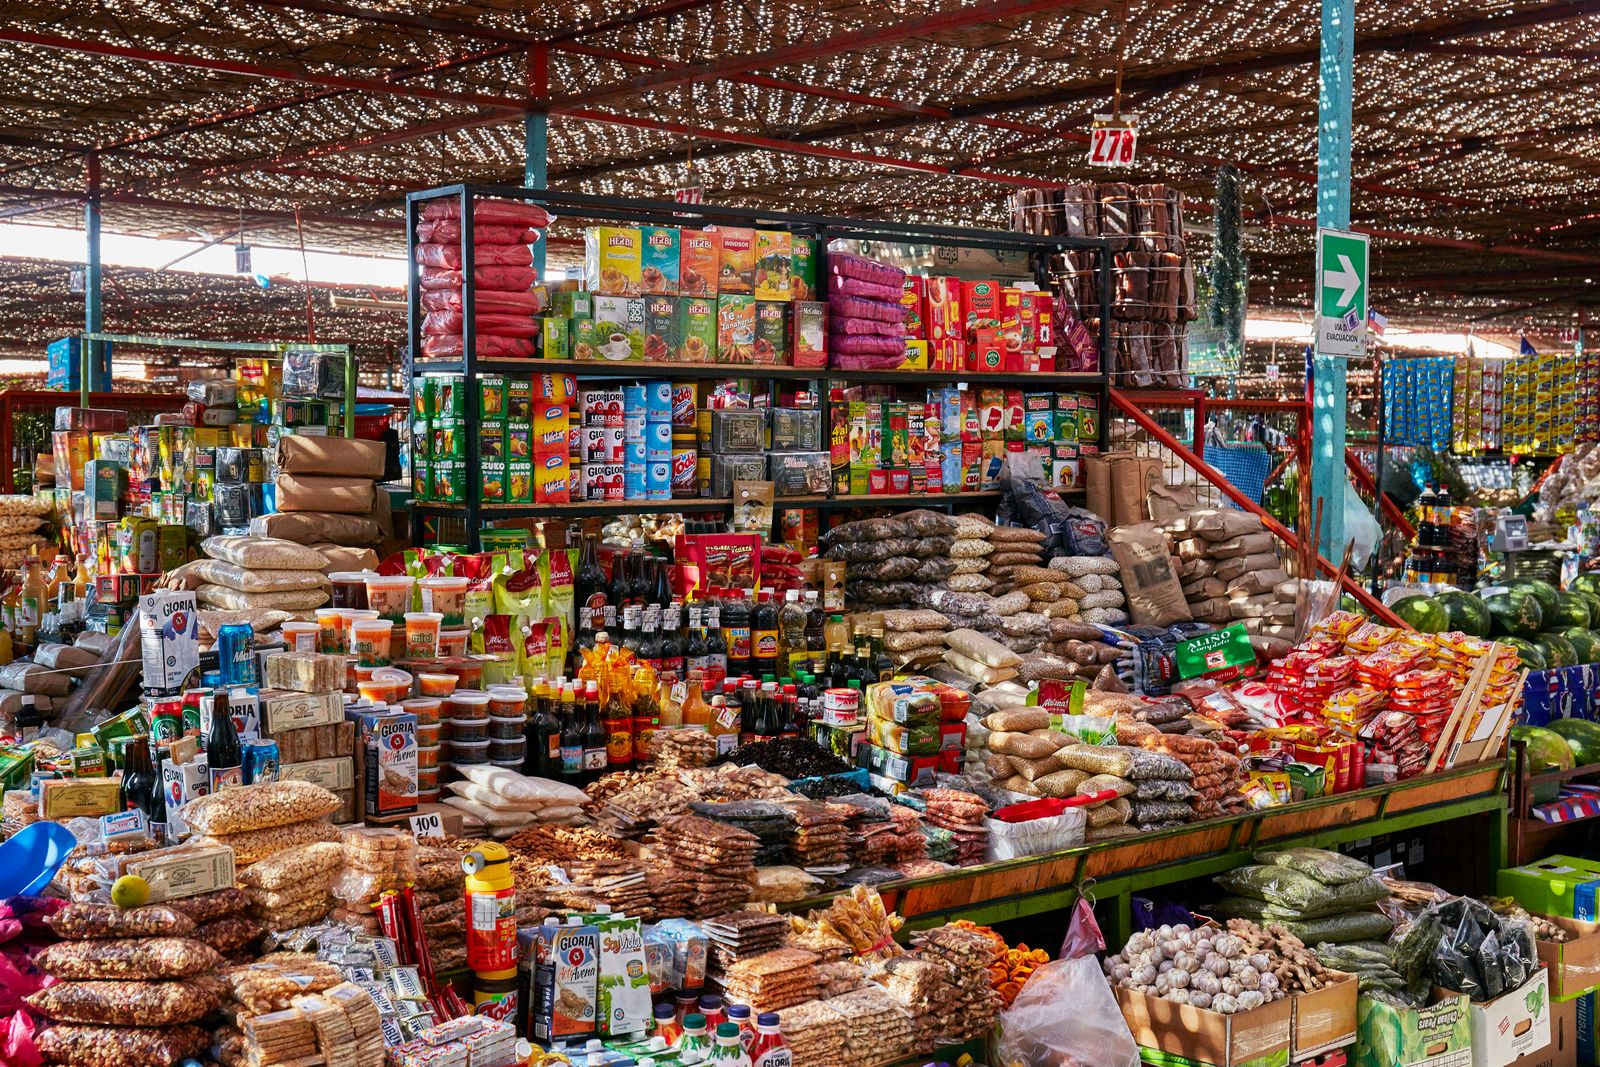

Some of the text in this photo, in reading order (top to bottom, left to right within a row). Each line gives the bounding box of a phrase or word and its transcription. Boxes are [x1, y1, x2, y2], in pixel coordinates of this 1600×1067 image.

[1092, 129, 1134, 163] 278
[608, 236, 633, 247] HERBI
[649, 236, 672, 246] HERBI
[689, 240, 712, 249] HERBI
[651, 304, 673, 313] HERBI
[689, 306, 711, 315] HERBI
[760, 309, 782, 318] HERBI
[721, 311, 735, 321] Té
[587, 394, 604, 403] GLO
[909, 420, 924, 429] Toro
[481, 462, 505, 470] ZUKO
[588, 467, 604, 477] GLO
[163, 599, 195, 617] GLORIA
[412, 633, 433, 643] miel
[1187, 631, 1231, 650] ALIÑO
[1190, 638, 1230, 653] Completo
[228, 704, 256, 718] ORIA
[381, 722, 414, 737] GLORIA
[80, 758, 101, 767] ZUKO
[415, 815, 439, 832] 100
[560, 935, 595, 951] GLORIA
[367, 986, 392, 1013] SUBLIM
[1418, 1010, 1458, 1031] Chilean Pears
